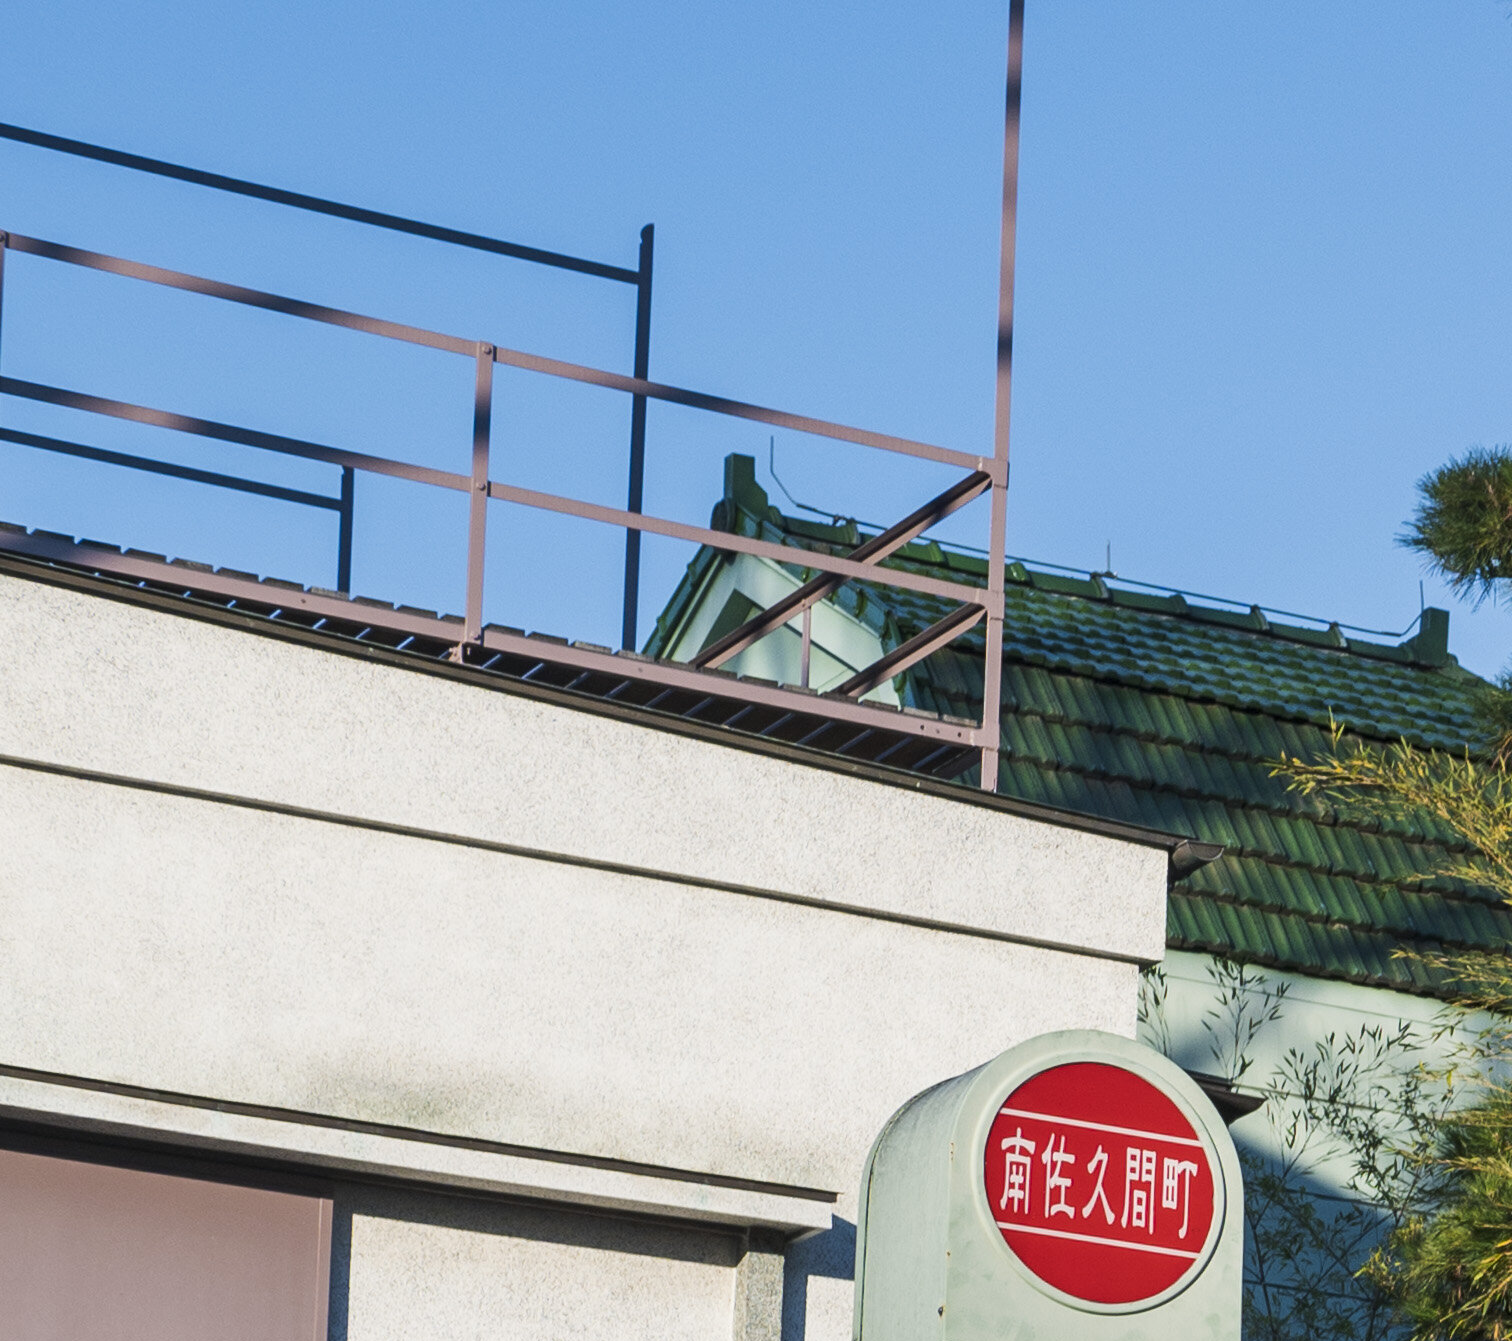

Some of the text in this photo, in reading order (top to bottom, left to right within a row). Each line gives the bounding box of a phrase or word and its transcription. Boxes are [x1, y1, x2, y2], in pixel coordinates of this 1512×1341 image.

[1000, 1127, 1198, 1239] 南佐久間町
